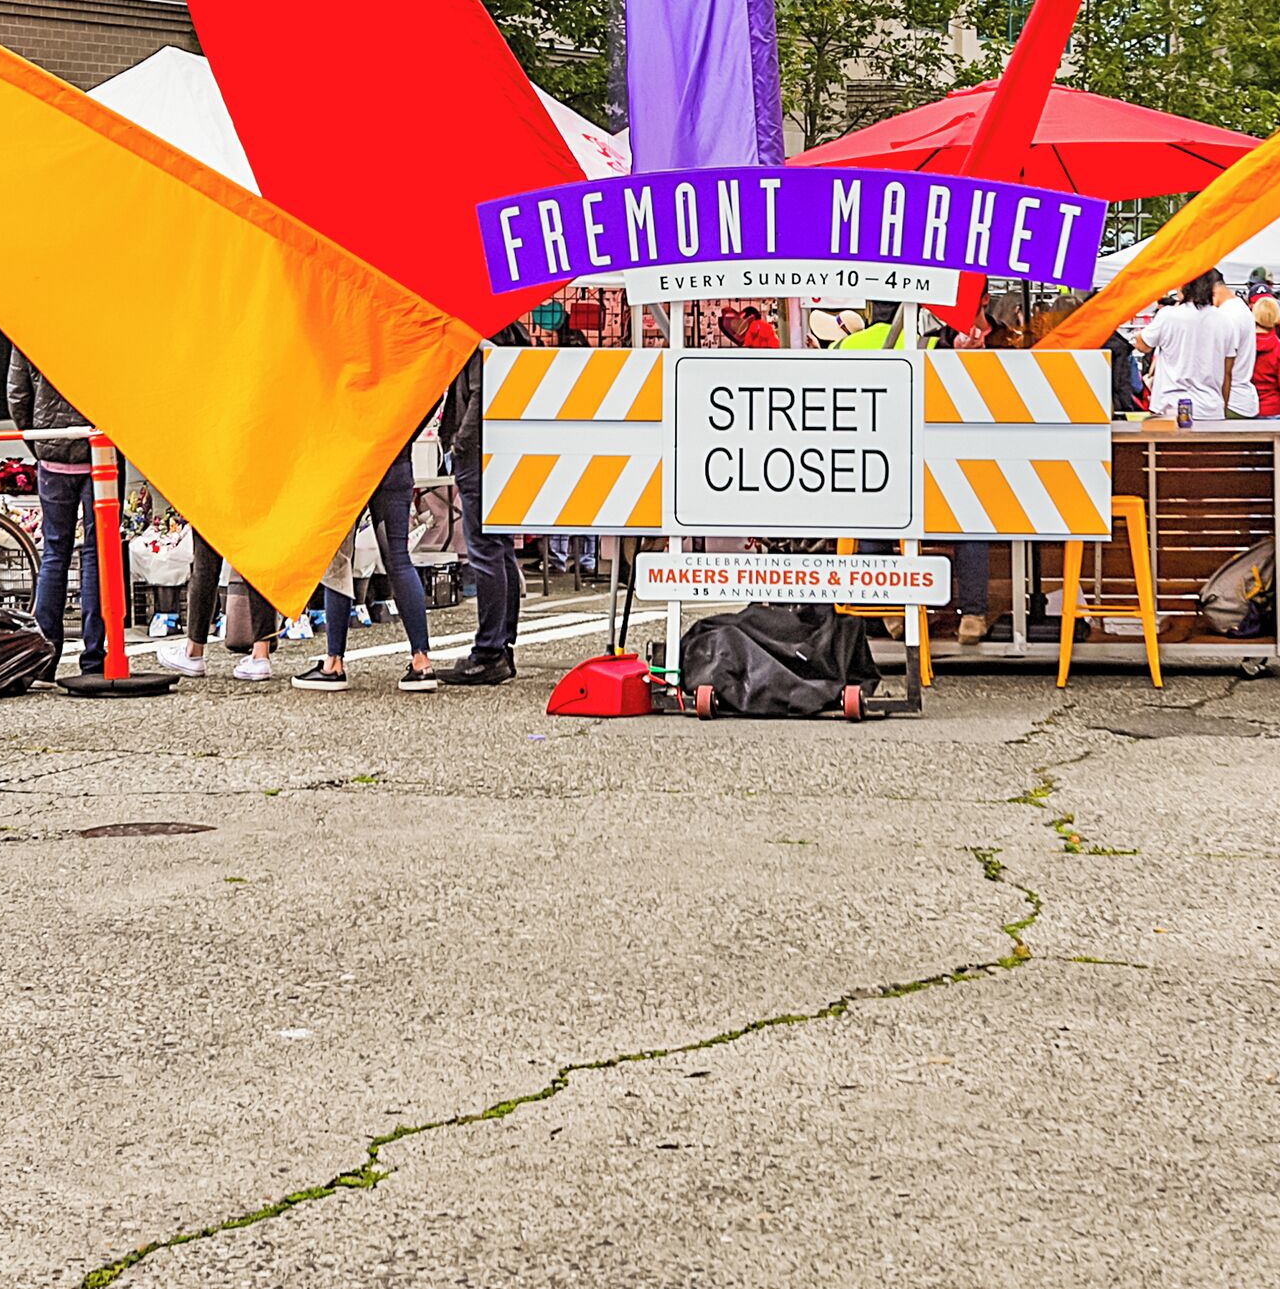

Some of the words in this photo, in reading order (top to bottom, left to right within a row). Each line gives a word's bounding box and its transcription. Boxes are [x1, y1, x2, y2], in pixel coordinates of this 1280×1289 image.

[498, 177, 781, 282] FREMONT
[830, 178, 1082, 279] MARKET
[708, 386, 888, 432] STREET
[704, 447, 890, 493] CLOSED
[648, 568, 729, 584] MAKERS
[737, 569, 820, 585] FINDERS
[827, 571, 841, 586] &
[849, 571, 934, 587] FOODIES
[685, 557, 791, 567] CELEBRATING
[802, 558, 899, 568] COMMUNITY
[719, 588, 838, 598] ANNIVERSARY
[848, 590, 890, 599] YEAR
